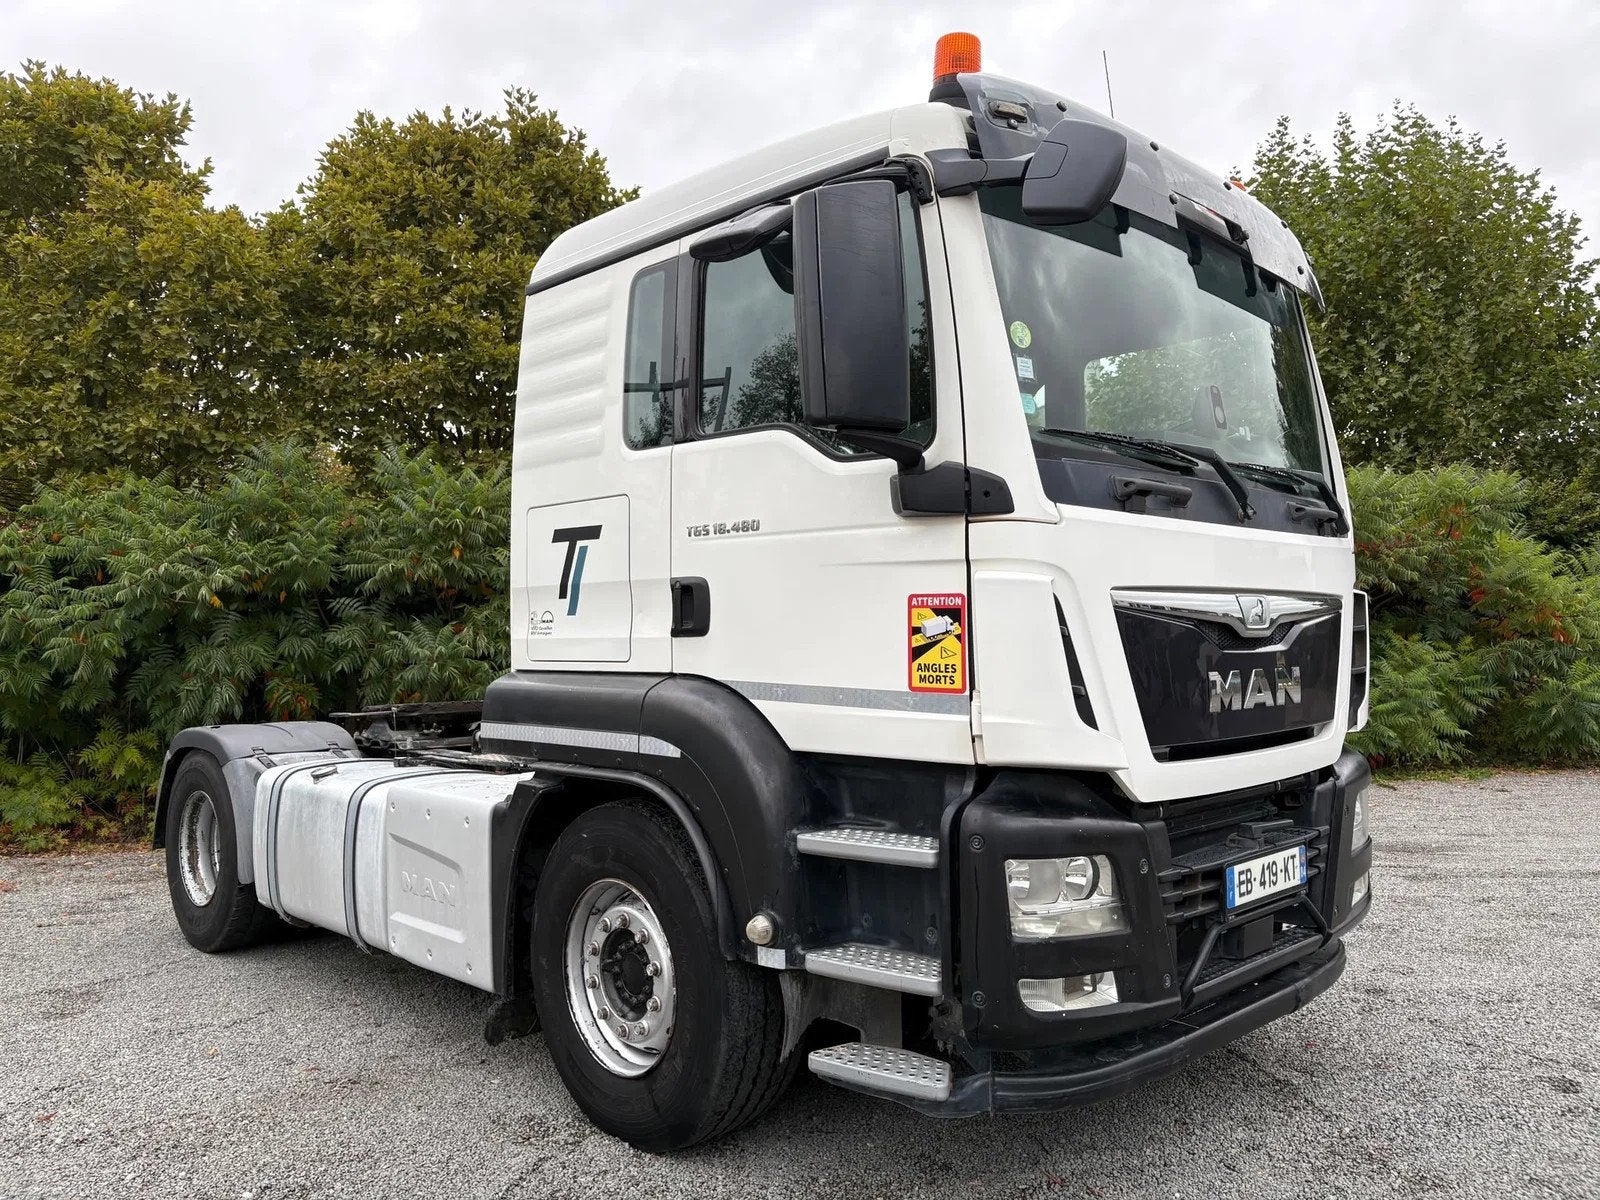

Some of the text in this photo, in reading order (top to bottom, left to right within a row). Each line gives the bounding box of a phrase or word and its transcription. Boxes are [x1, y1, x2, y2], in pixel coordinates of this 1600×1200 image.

[686, 519, 760, 537] TGS 18.480
[911, 597, 962, 606] ATTENTION
[917, 663, 957, 674] ANGLES
[919, 674, 955, 685] MORTS
[1208, 666, 1301, 713] MAN
[402, 871, 456, 908] MAN
